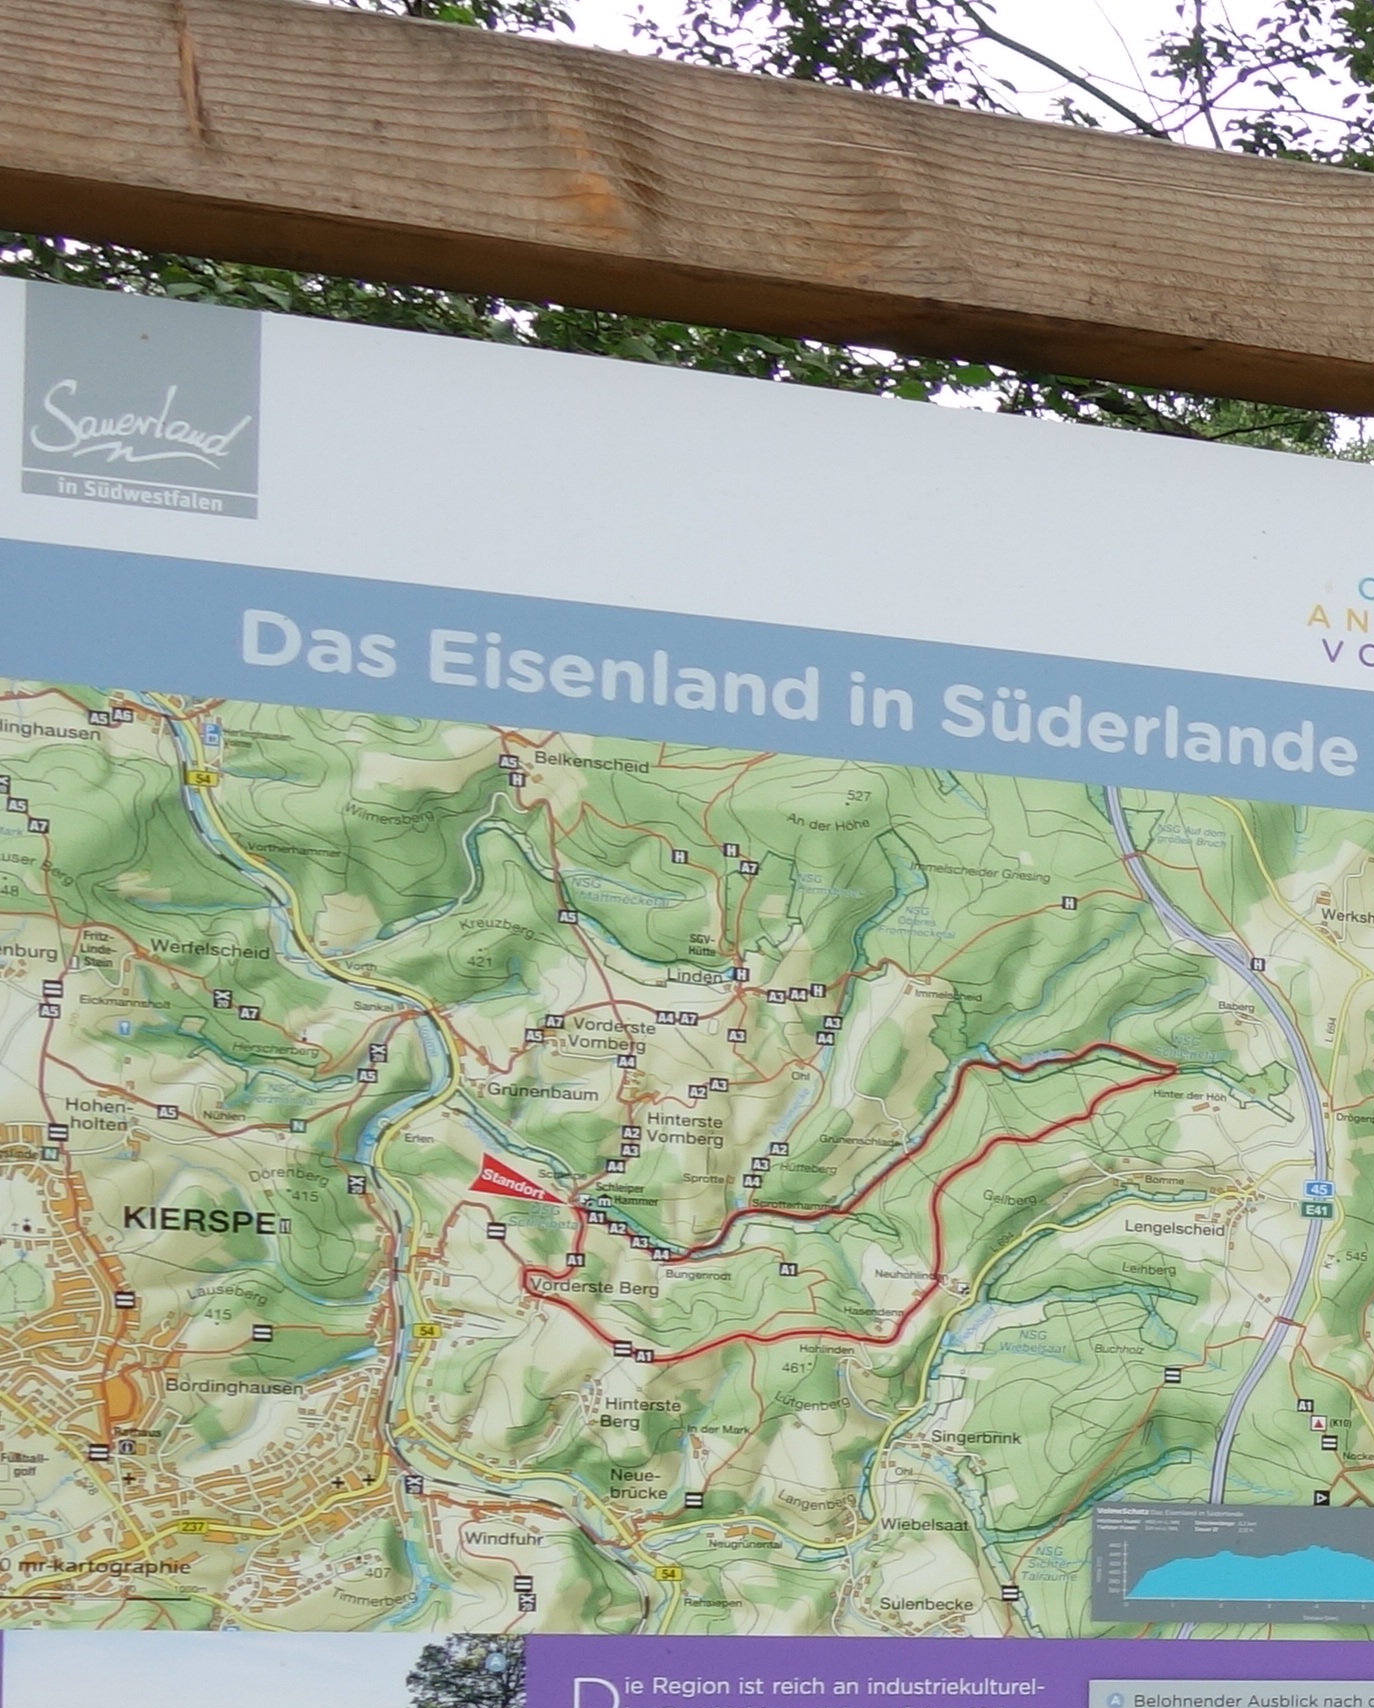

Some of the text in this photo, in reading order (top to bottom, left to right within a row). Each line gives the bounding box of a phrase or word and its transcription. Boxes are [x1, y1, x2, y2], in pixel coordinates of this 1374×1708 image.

[30, 378, 252, 457] Sauerland
[58, 477, 223, 512] in Südwestfalen
[1307, 604, 1369, 633] AN
[243, 609, 1358, 776] Das Eisenland in Süderlande
[534, 751, 650, 774] Belkenscheid
[195, 772, 212, 785] 54
[847, 790, 871, 802] 527
[150, 938, 270, 960] Werfelscheid
[666, 967, 723, 985] Linden
[65, 1097, 134, 1116] Hohen-
[70, 1115, 128, 1133] holten
[481, 1168, 546, 1200] Standort
[1310, 1183, 1328, 1196] 45
[1306, 1204, 1329, 1217] E41
[123, 1206, 276, 1235] KIERSPE
[1125, 1219, 1225, 1238] Lengelscheid
[531, 1279, 659, 1298] Vorderste Berg
[420, 1326, 435, 1337] 54
[604, 1397, 682, 1413] Hinterste
[600, 1414, 640, 1432] Berg
[930, 1429, 1022, 1447] Singerbrink
[610, 1468, 661, 1483] Neue-
[610, 1485, 668, 1501] brücke
[181, 1521, 205, 1533] 237
[880, 1517, 969, 1533] Wiebelsaat
[465, 1530, 543, 1547] Windfuhr
[18, 1557, 191, 1576] mr-kartographie
[662, 1569, 675, 1580] 54
[653, 1677, 729, 1697] Region
[740, 1677, 764, 1694] ist
[773, 1677, 824, 1694] reich
[833, 1682, 858, 1694] an
[868, 1678, 1045, 1695] industriekulturel-
[1135, 1695, 1242, 1707] Belohnender
[1248, 1695, 1318, 1707] Ausblick
[1324, 1695, 1362, 1707] nach
